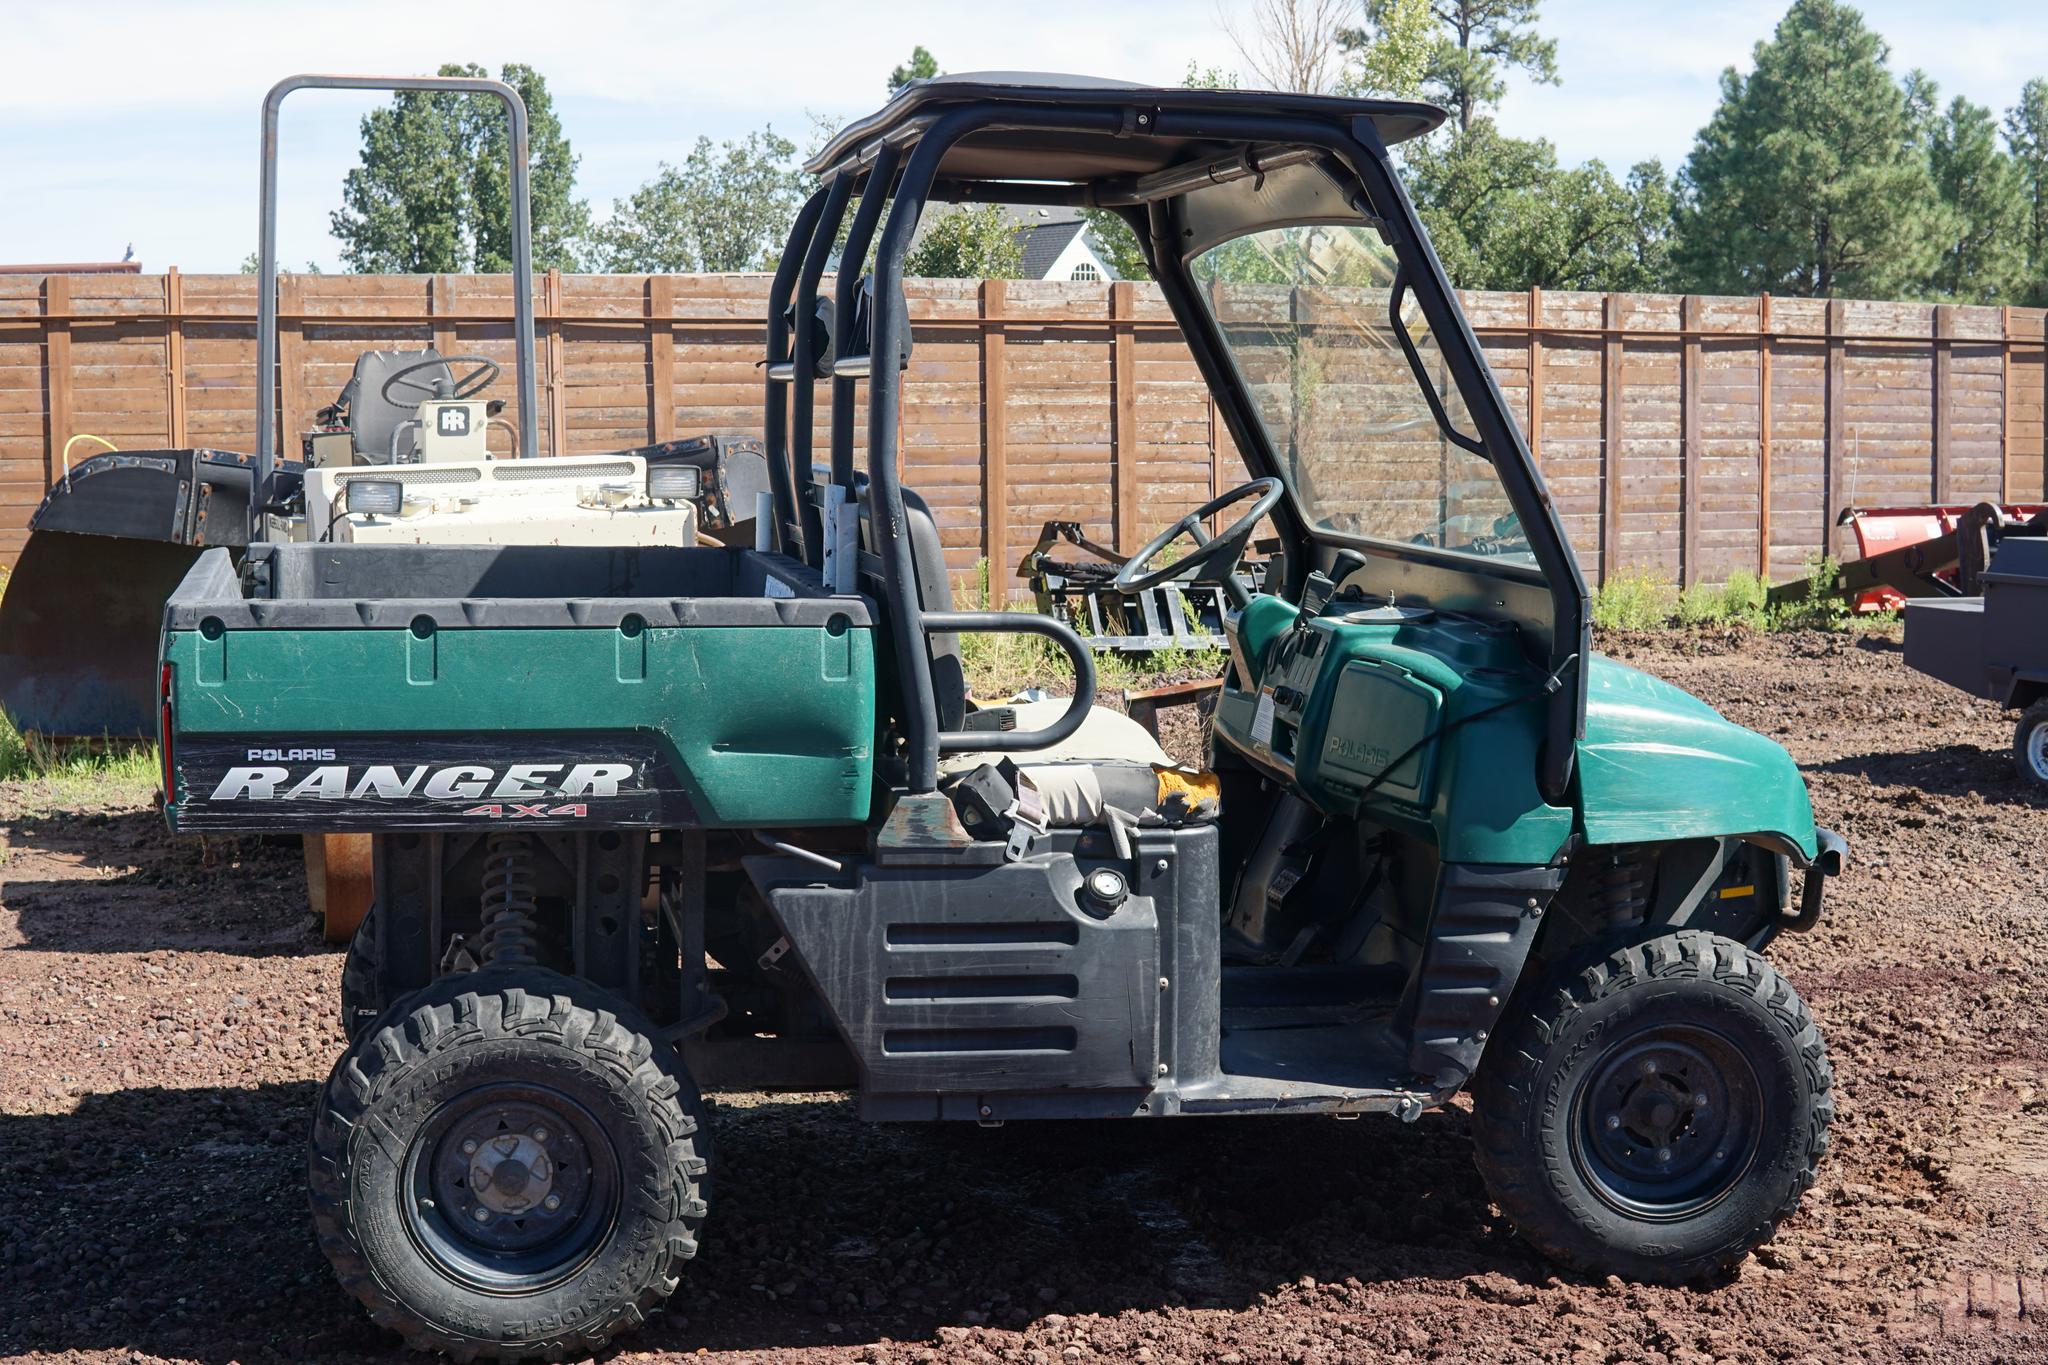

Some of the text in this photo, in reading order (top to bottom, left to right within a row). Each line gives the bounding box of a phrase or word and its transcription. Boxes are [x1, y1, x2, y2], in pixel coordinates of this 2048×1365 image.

[247, 748, 336, 762] POLARIS
[1329, 736, 1390, 768] POLARIS
[210, 763, 632, 800] RANGER
[462, 803, 588, 818] 4X4
